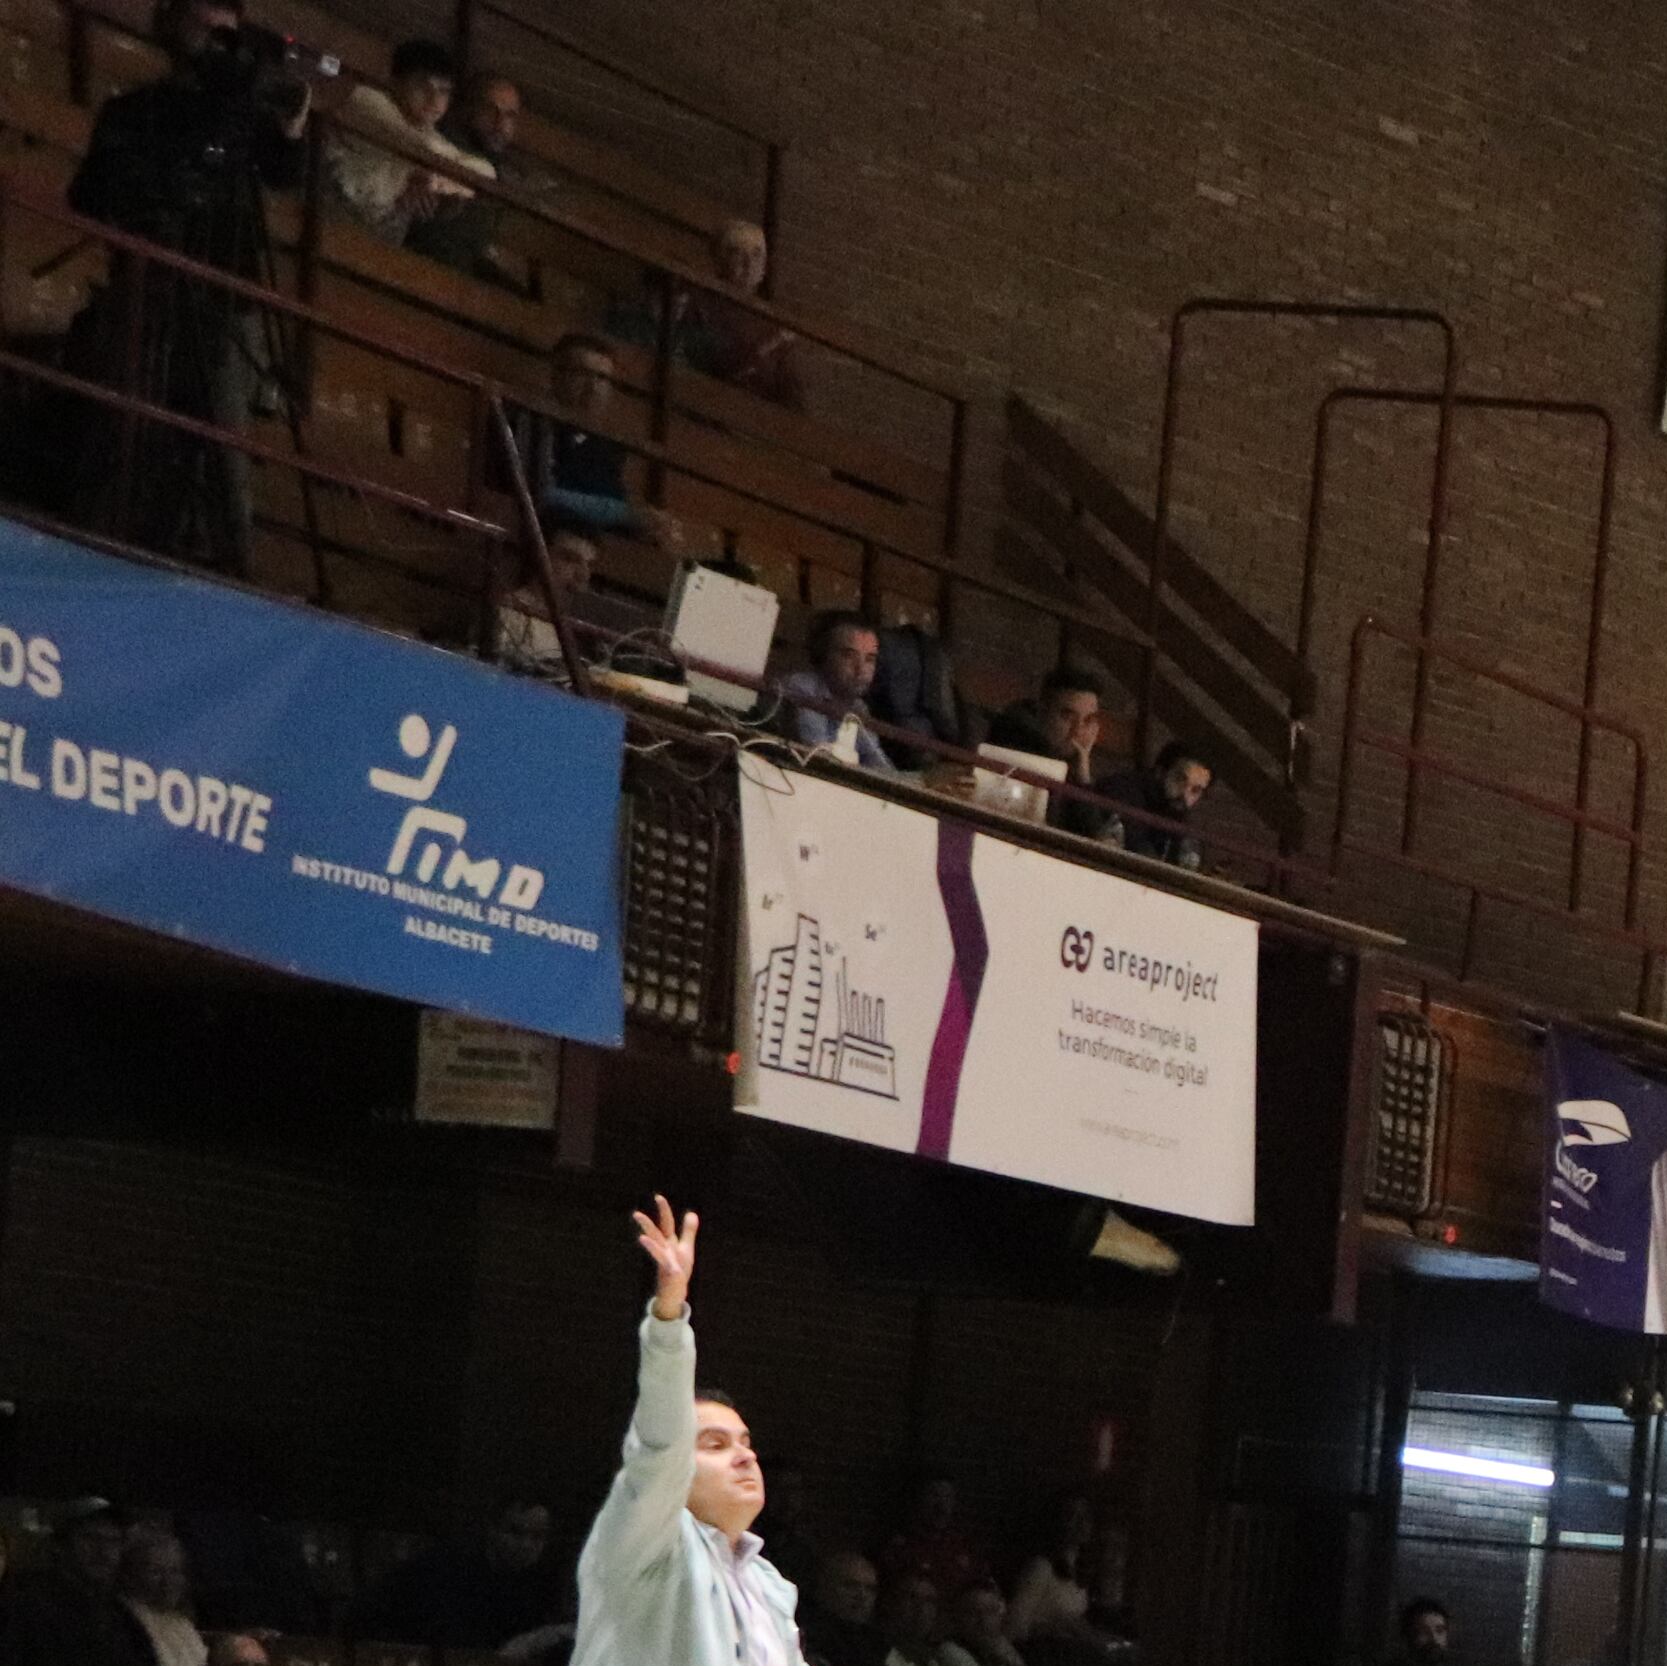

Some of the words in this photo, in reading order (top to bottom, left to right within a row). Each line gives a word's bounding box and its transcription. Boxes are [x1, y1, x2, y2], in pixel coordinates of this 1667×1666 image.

[52, 738, 272, 853] DEPORTE
[292, 854, 390, 895] INSTITUTO
[393, 882, 485, 922] MUNICIPAL
[487, 907, 513, 928] DE
[515, 914, 599, 951] DEPORTES
[404, 916, 492, 954] ALBACETE
[1103, 947, 1219, 1002] areaproject
[1071, 999, 1136, 1036] Hacemos
[1139, 1019, 1181, 1048] simple
[1185, 1031, 1197, 1052] la
[1164, 1058, 1208, 1087] digital
